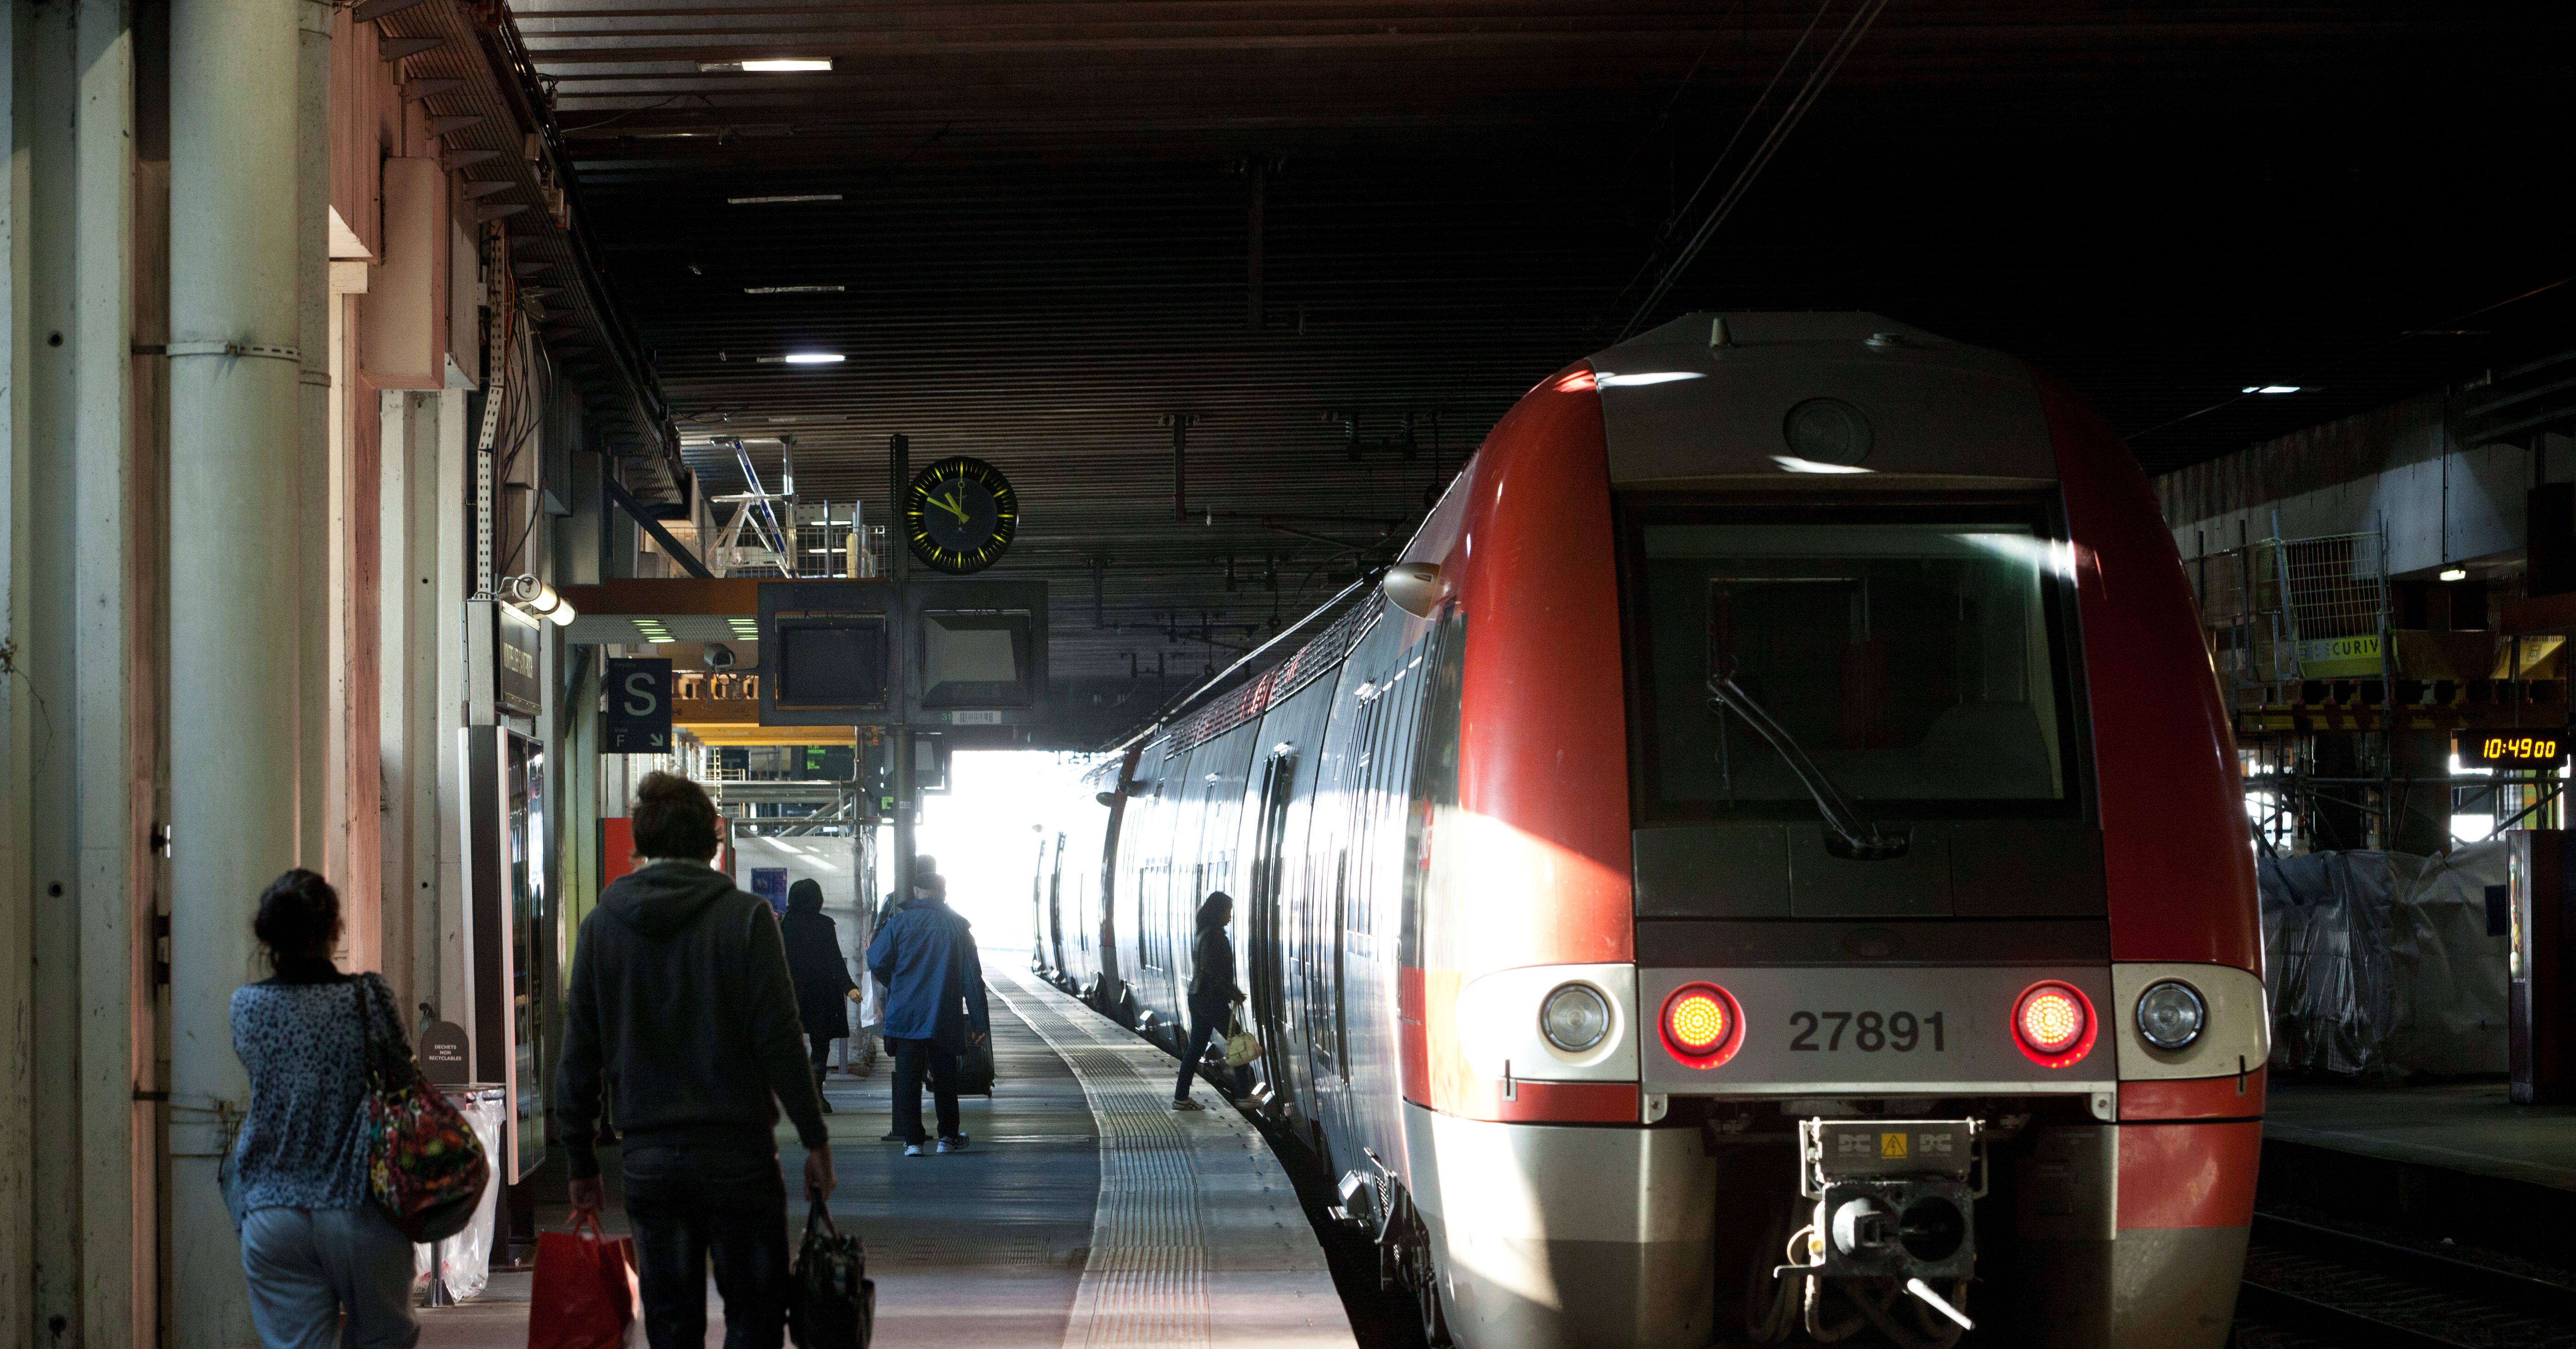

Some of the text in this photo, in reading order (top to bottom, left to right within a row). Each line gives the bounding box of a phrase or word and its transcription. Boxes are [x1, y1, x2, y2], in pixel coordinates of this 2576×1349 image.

[624, 672, 656, 716] S
[616, 735, 625, 747] F
[2483, 738, 2555, 758] 10:49 00
[1789, 1011, 1944, 1052] 27891
